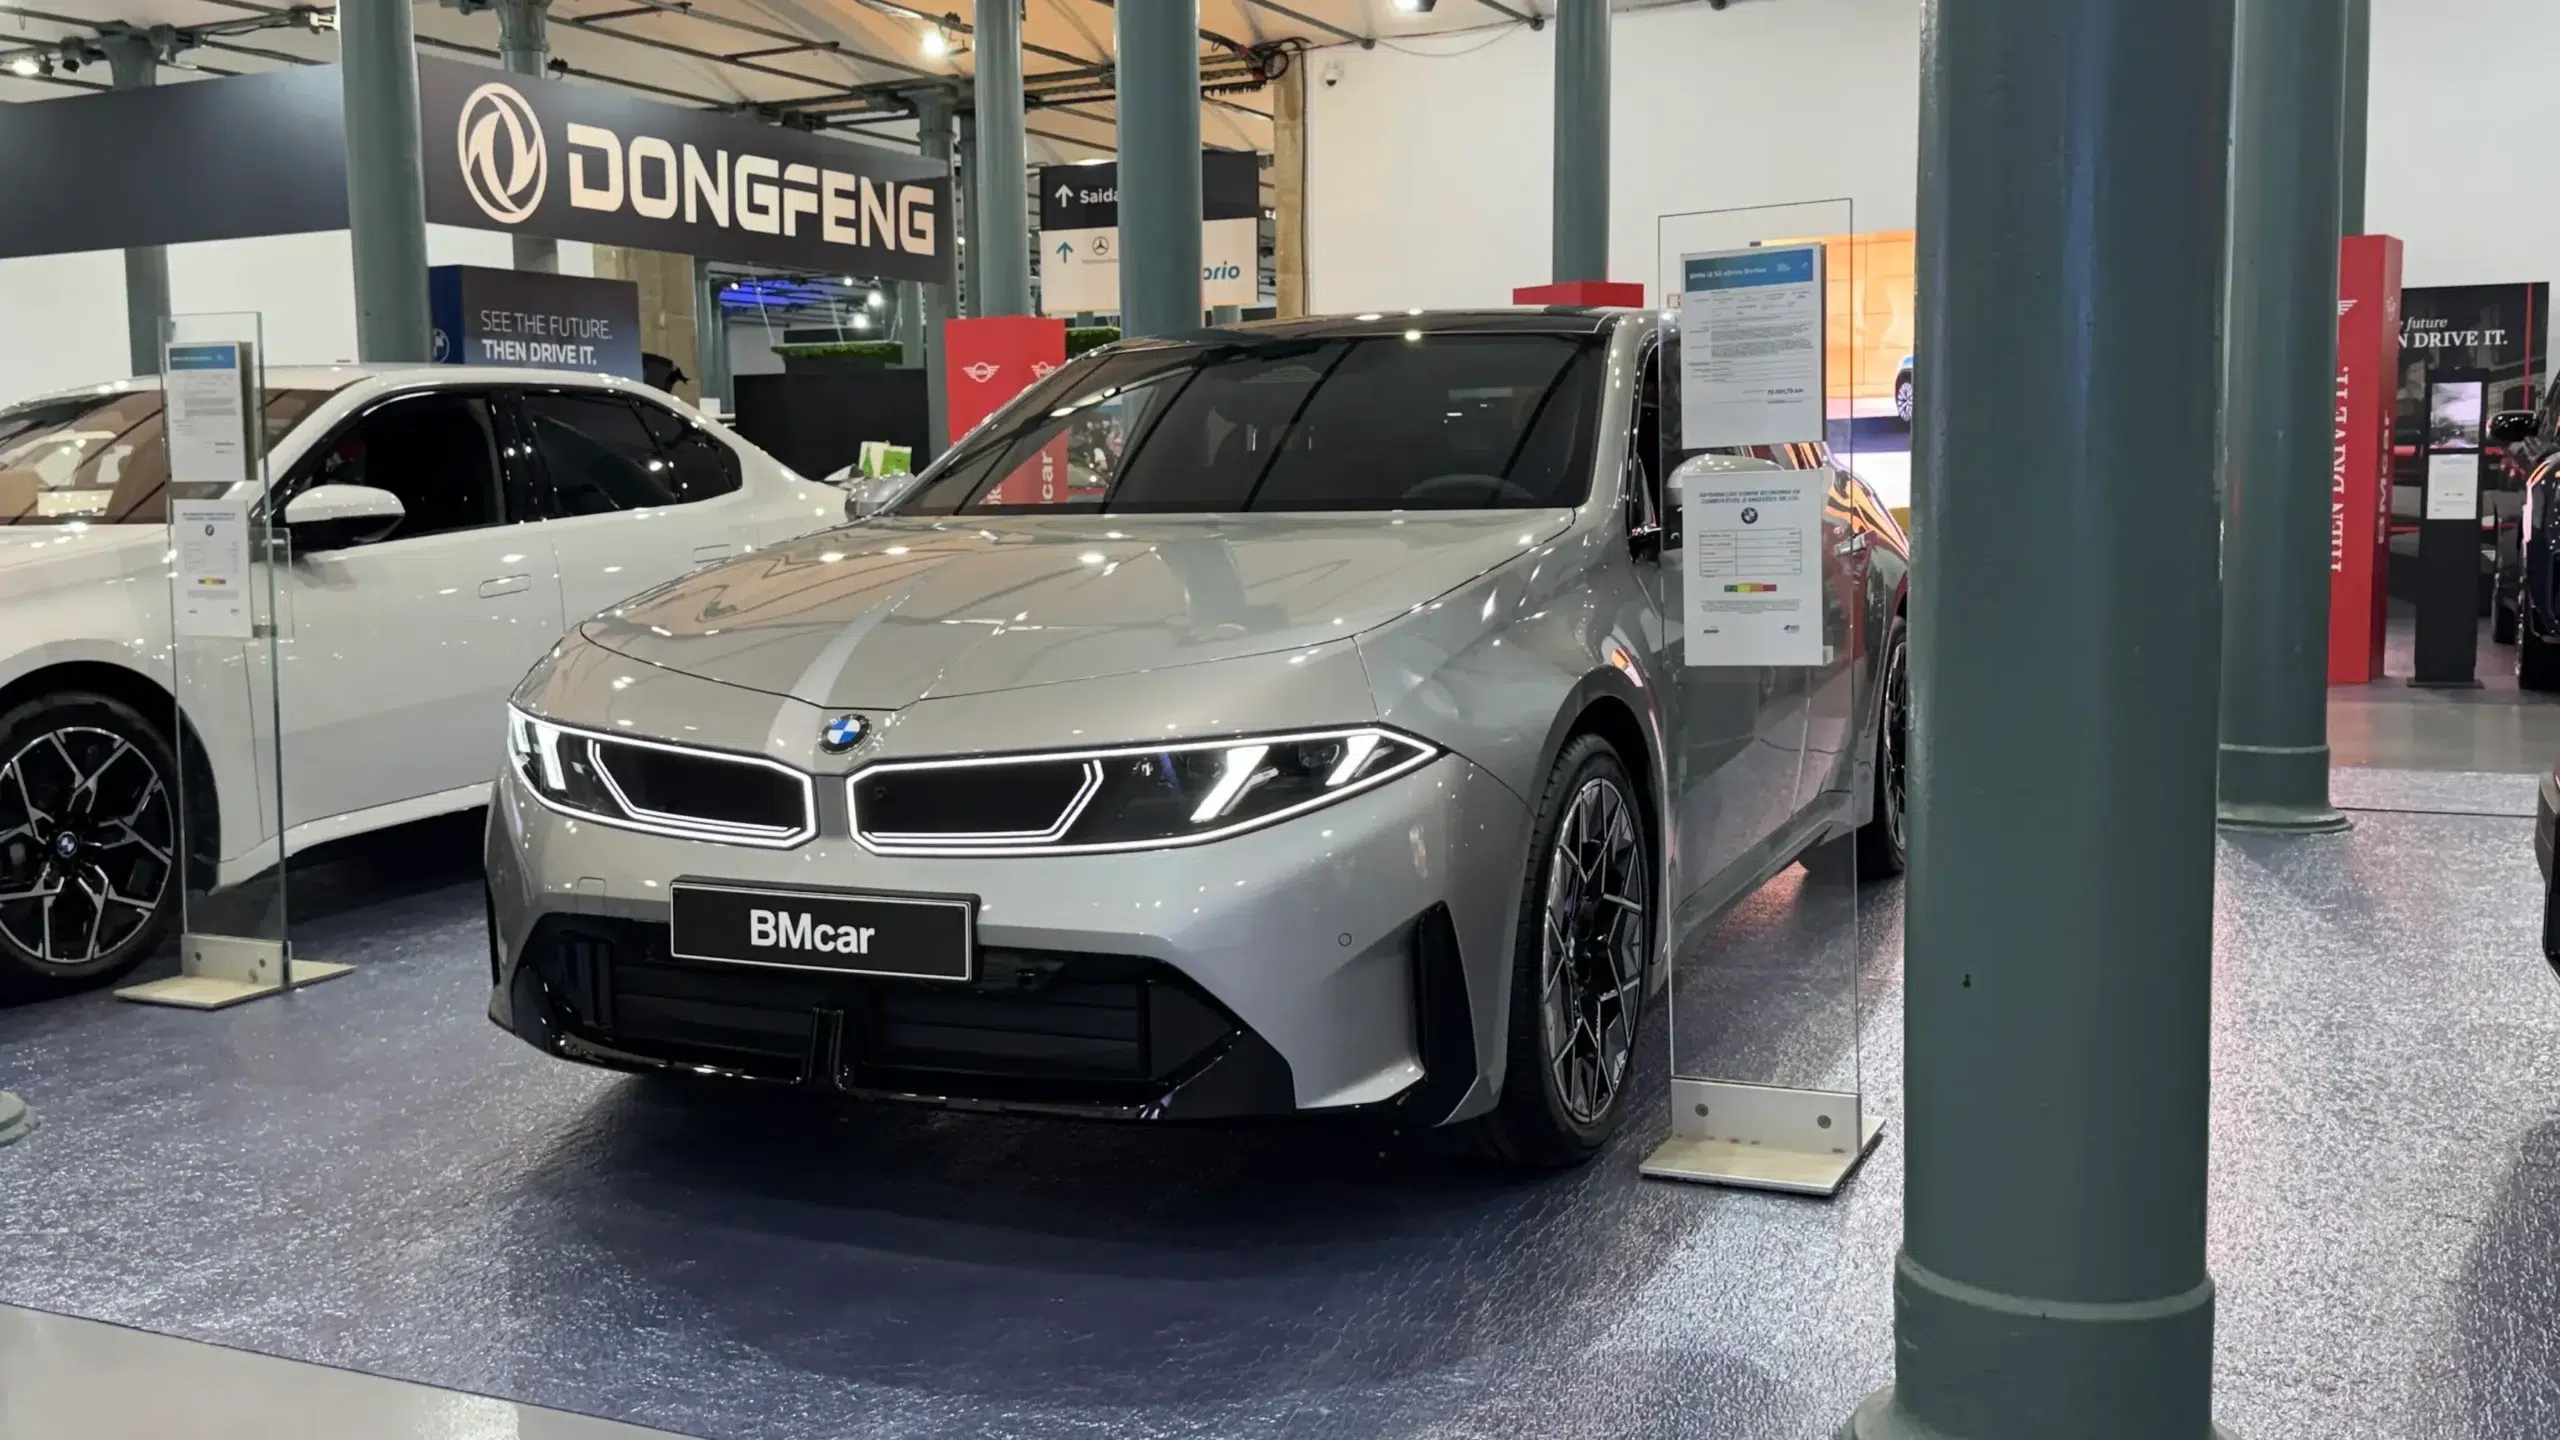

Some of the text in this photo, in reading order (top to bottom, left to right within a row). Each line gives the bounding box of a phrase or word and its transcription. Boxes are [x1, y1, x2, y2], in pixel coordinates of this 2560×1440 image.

[567, 122, 935, 257] DONGFENG
[481, 310, 613, 339] SEE THE FUTURE.
[2406, 317, 2448, 332] future
[2413, 331, 2478, 348] DRIVE
[2484, 329, 2508, 346] IT.
[482, 339, 597, 366] THEN DRIVE IT.
[750, 909, 875, 955] BMcar
